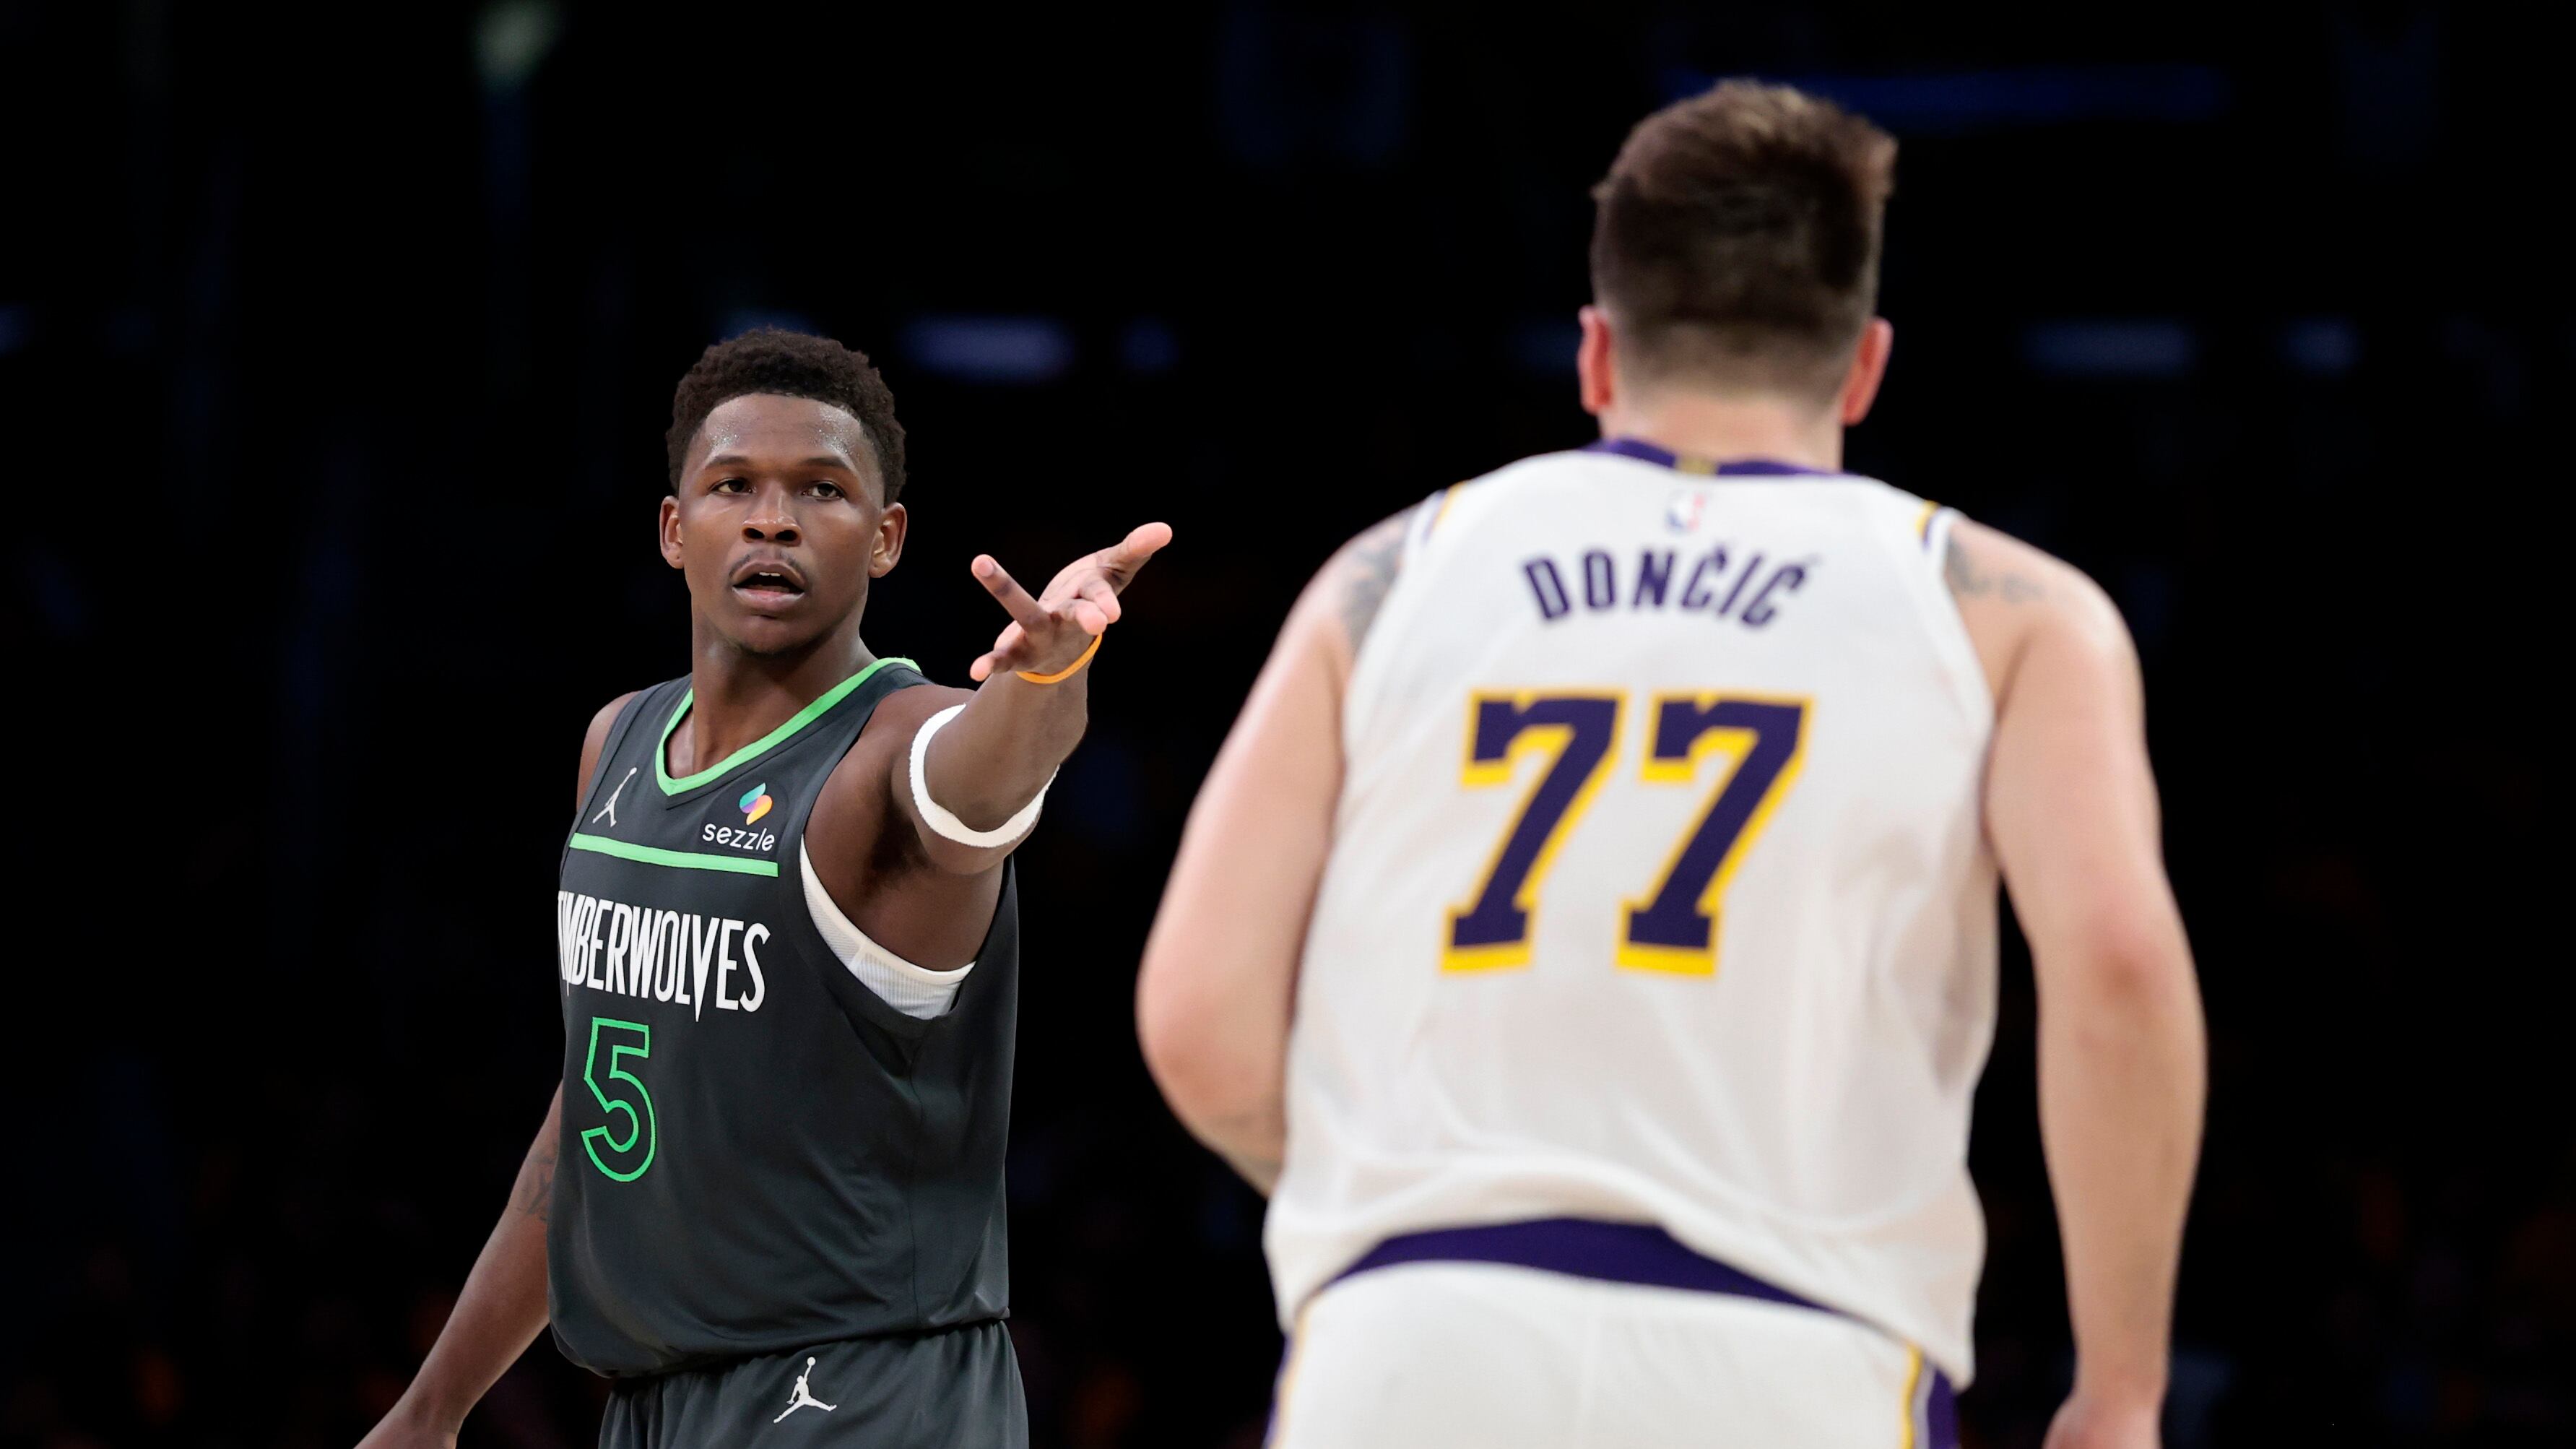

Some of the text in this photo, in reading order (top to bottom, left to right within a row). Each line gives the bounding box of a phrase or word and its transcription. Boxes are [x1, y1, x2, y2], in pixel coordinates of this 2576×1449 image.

[702, 823, 775, 852] sezzle
[1441, 688, 1813, 978] 77
[581, 1016, 656, 1182] 5
